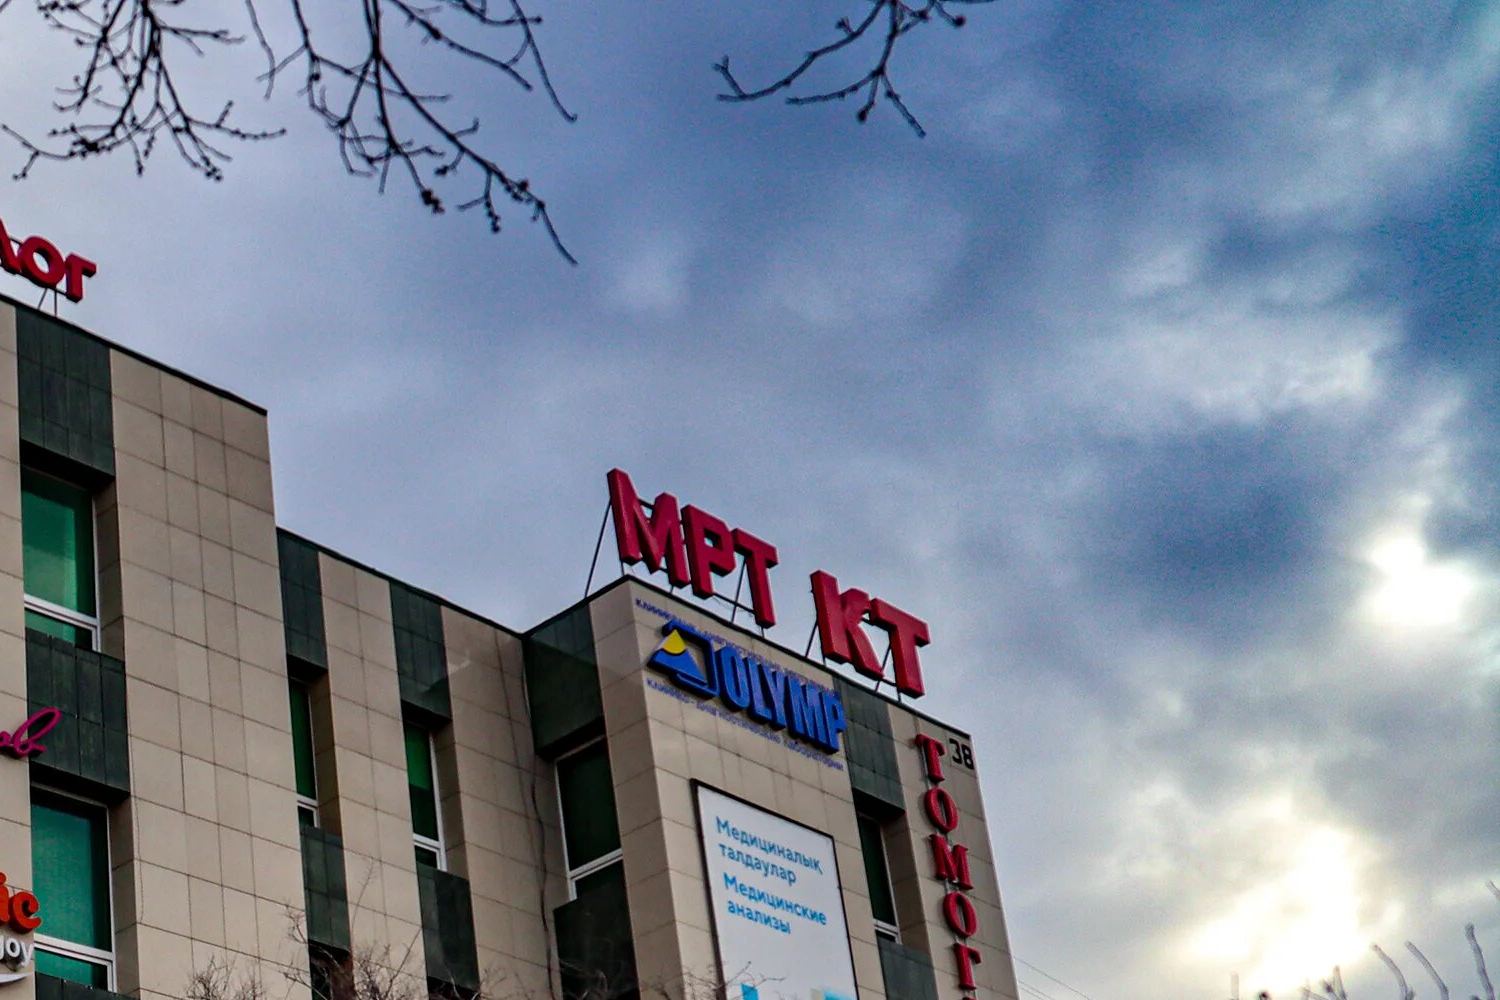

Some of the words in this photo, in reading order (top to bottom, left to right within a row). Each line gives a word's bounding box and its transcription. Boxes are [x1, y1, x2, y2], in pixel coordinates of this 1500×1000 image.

[607, 468, 779, 628] МРТ
[810, 570, 931, 699] КТ
[716, 645, 846, 754] OLYMP
[948, 738, 975, 770] 38
[716, 816, 823, 875] Медициналық
[719, 843, 797, 887] талдаулар
[723, 872, 827, 926] Медицинские
[727, 900, 791, 934] анализы
